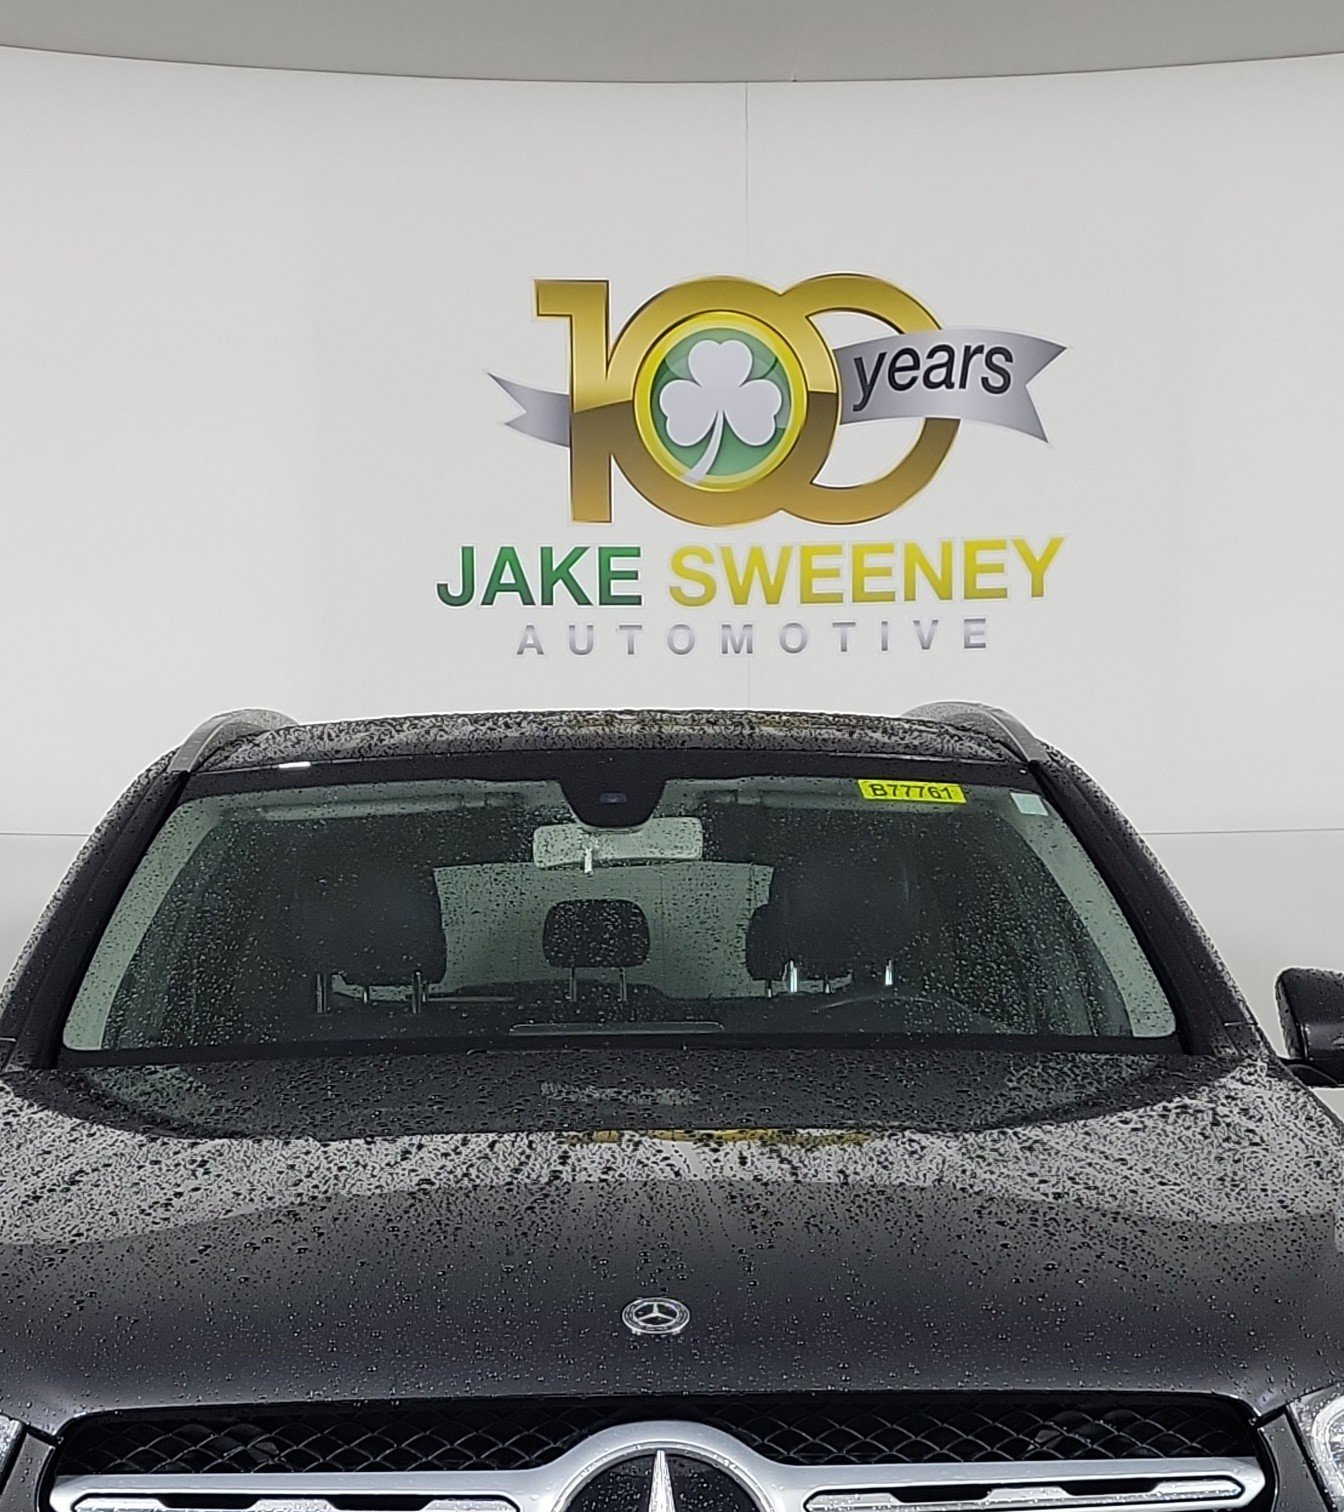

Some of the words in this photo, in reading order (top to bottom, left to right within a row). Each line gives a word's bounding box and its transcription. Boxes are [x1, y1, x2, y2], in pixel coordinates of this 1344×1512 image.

[534, 273, 959, 526] 100
[851, 342, 1013, 412] years
[436, 545, 642, 607] JAKE
[669, 537, 1063, 607] SWEENEY
[516, 617, 987, 656] AUTOMOTIVE
[869, 783, 954, 800] B77761
